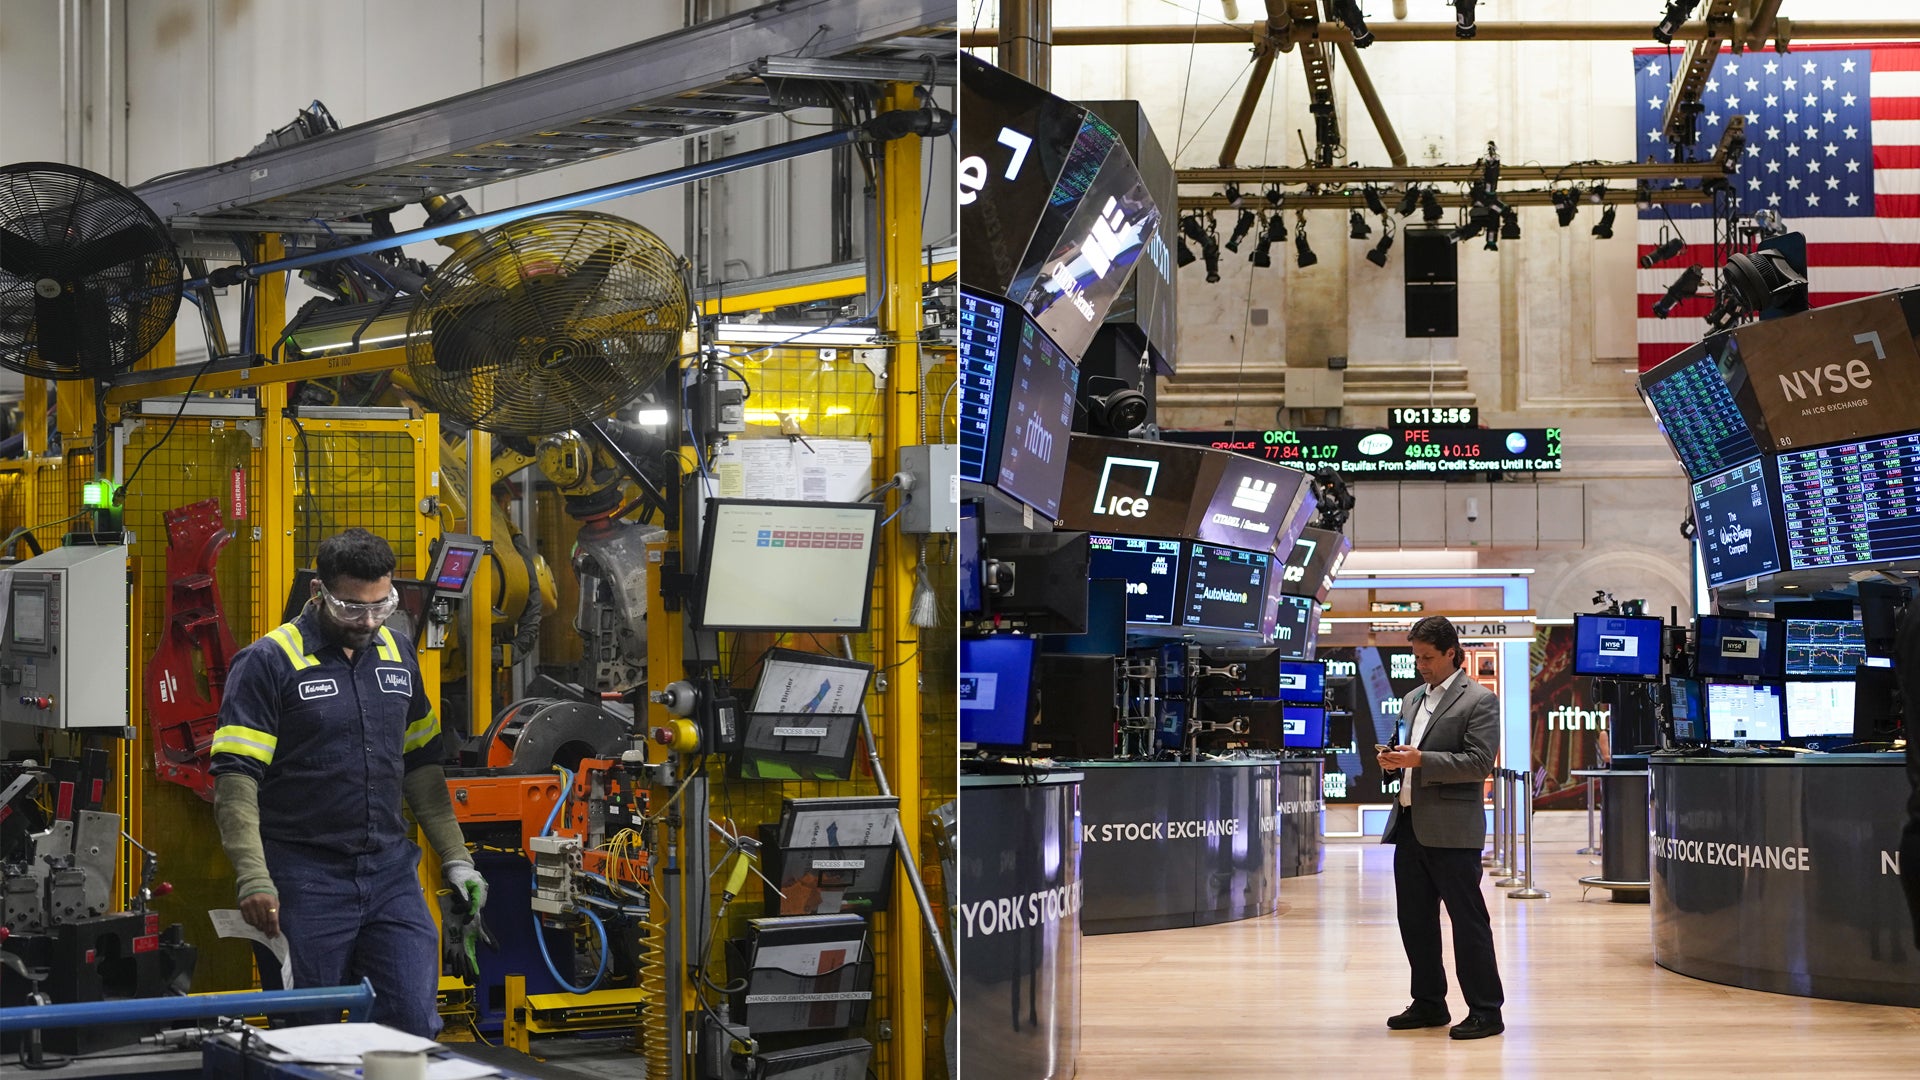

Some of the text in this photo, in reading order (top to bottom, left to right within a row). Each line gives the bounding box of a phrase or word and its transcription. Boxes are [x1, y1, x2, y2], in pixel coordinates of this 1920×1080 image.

[1393, 408, 1471, 424] 10:13:56
[1801, 408, 1812, 417] AN
[1024, 410, 1053, 464] rithm
[1211, 441, 1256, 451] ORACLE
[1263, 430, 1301, 444] ORCL
[1404, 430, 1430, 443] PFE
[1779, 436, 1792, 447] 80
[1264, 445, 1299, 459] 77.84
[1311, 445, 1339, 458] 1.07
[1404, 444, 1441, 458] 49.63
[1452, 444, 1480, 457] 0.16
[1305, 461, 1317, 472] to
[1341, 460, 1377, 472] Equifax
[1378, 459, 1404, 471] From
[1404, 459, 1437, 472] Selling
[1437, 458, 1468, 471] Credit
[1468, 458, 1501, 471] Scores
[1501, 458, 1524, 470] Until
[1524, 458, 1534, 470] It
[1534, 458, 1555, 470] Can
[1727, 511, 1738, 522] The
[1728, 543, 1748, 556] Company
[452, 561, 460, 571] 2
[1203, 586, 1242, 604] AutoNation
[1480, 623, 1507, 635] AIR
[1390, 653, 1416, 664] RITM
[1390, 669, 1416, 679] NYSE
[781, 678, 794, 703] Binder
[774, 728, 826, 736] PROCESS BINDER
[1280, 800, 1299, 815] NEW
[1299, 800, 1316, 814] YORK
[1101, 821, 1164, 843] STOCK
[1167, 818, 1239, 840] EXCHANGE
[1260, 815, 1274, 833] NEW
[1667, 838, 1705, 864] STOCK
[1707, 842, 1811, 872] EXCHANGE
[813, 860, 865, 869] PROCESS BINDER
[961, 895, 1025, 938] YORK
[1028, 885, 1072, 928] STOCK
[746, 994, 769, 1003] CHANGE
[769, 994, 788, 1002] OVER
[799, 991, 871, 1001] CHANGE OVER CHECKLIST
